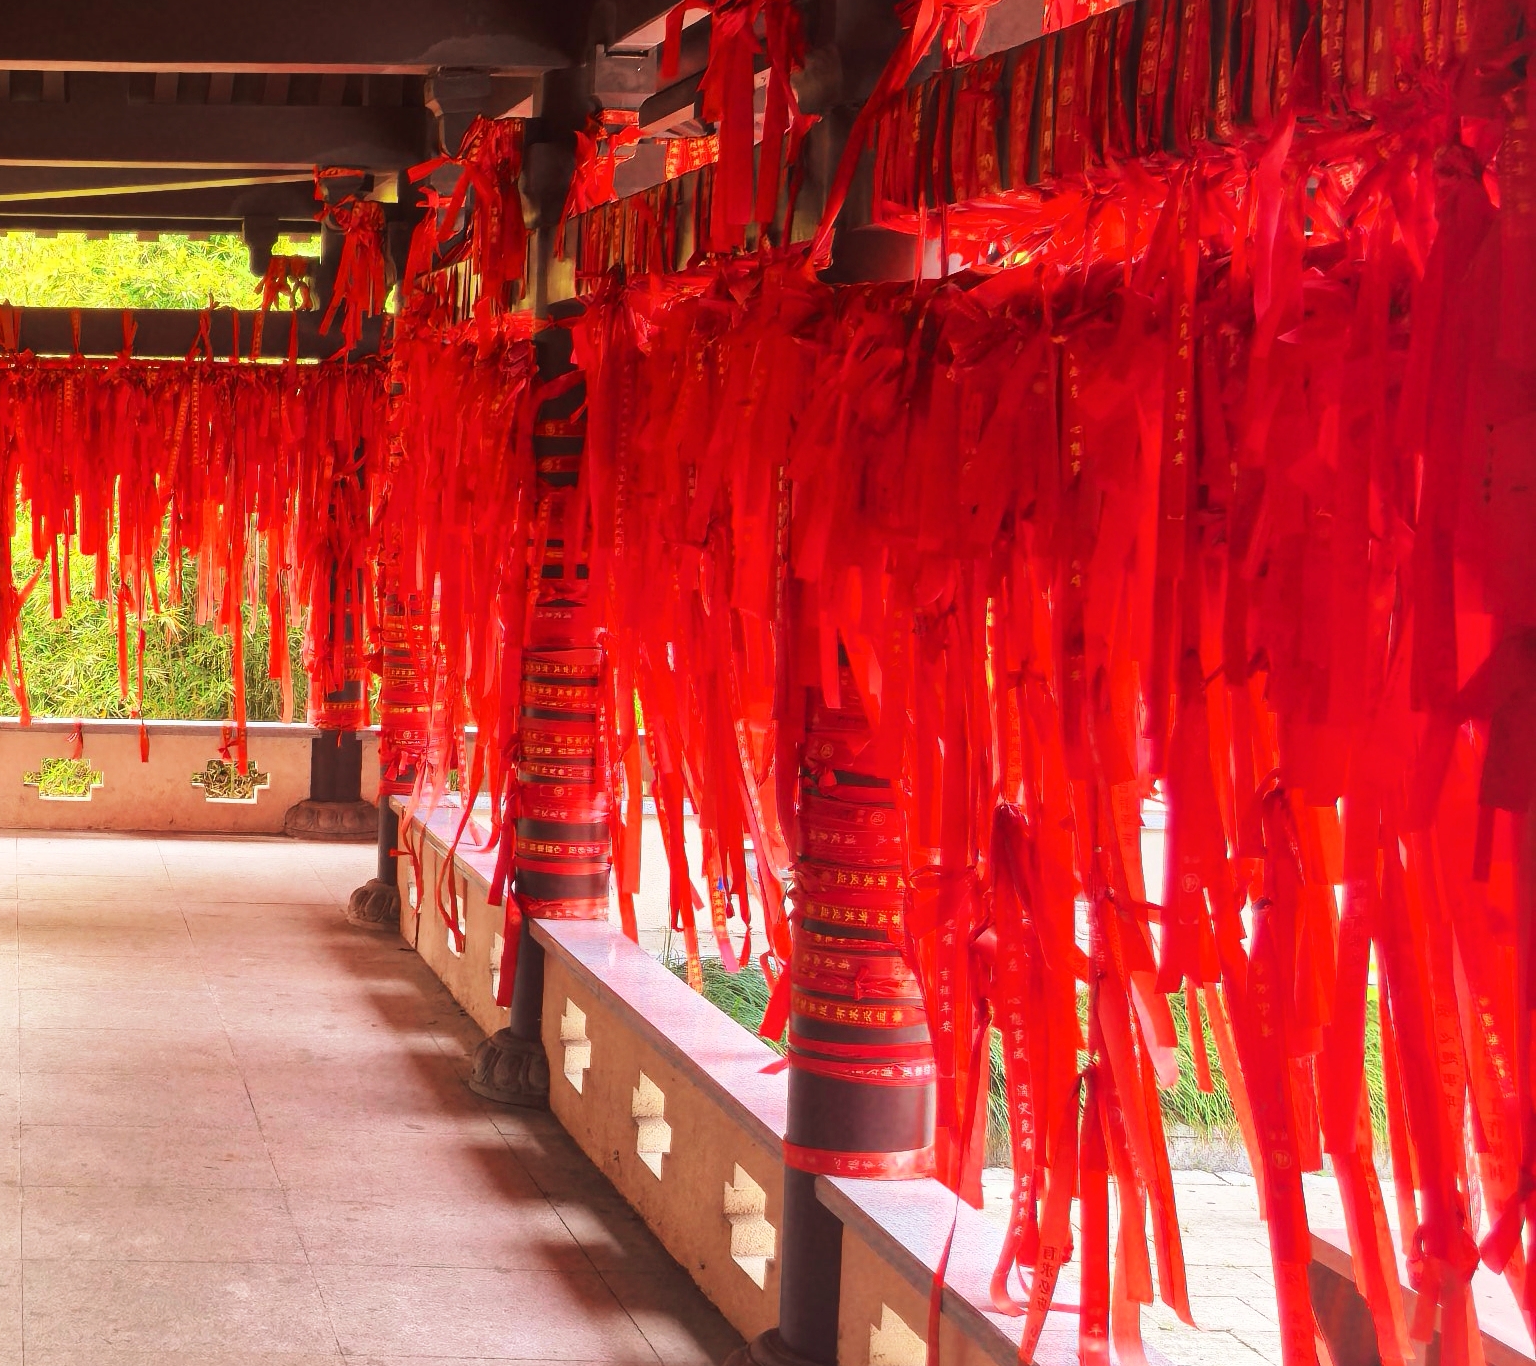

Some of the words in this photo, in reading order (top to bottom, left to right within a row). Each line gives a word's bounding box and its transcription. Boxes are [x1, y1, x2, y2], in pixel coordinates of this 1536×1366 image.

[1173, 387, 1189, 465] 吉祥平安
[836, 1006, 888, 1023] 有求必应
[939, 969, 954, 1033] 吉祥平安
[1007, 996, 1029, 1063] 心想事成
[1017, 1082, 1035, 1151] 消灾免难
